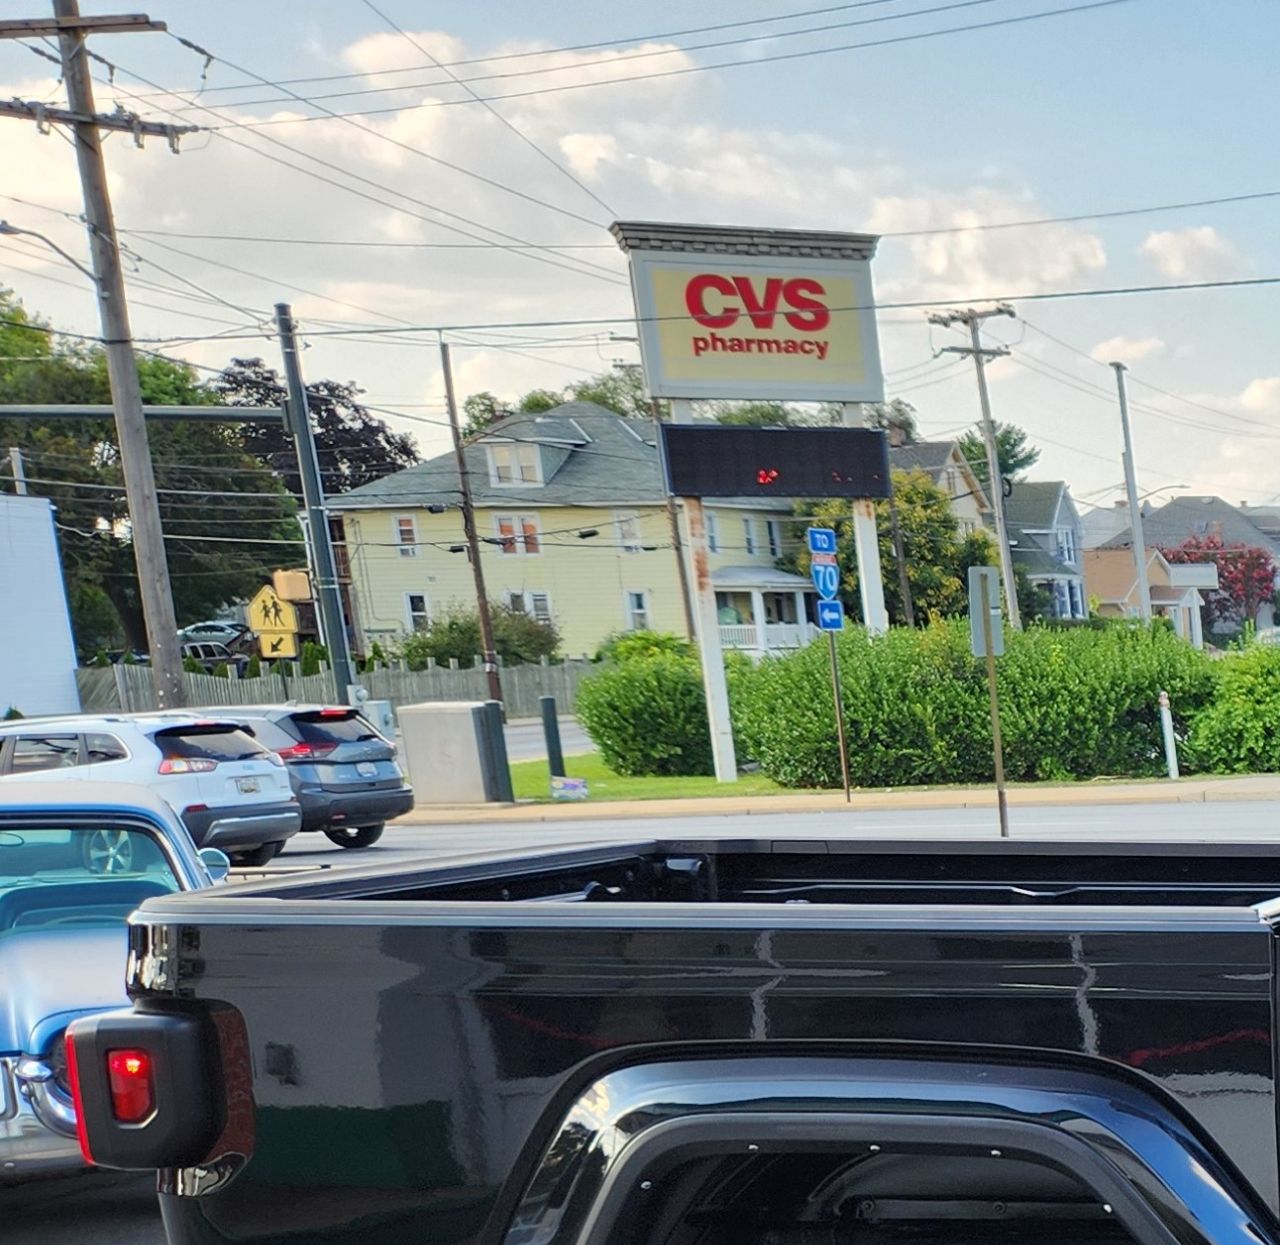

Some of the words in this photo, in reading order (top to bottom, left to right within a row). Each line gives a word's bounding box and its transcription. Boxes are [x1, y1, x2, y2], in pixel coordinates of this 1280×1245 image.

[685, 274, 831, 331] CVS
[692, 332, 829, 360] pharmacy
[814, 533, 829, 549] TO
[815, 565, 836, 591] 70
